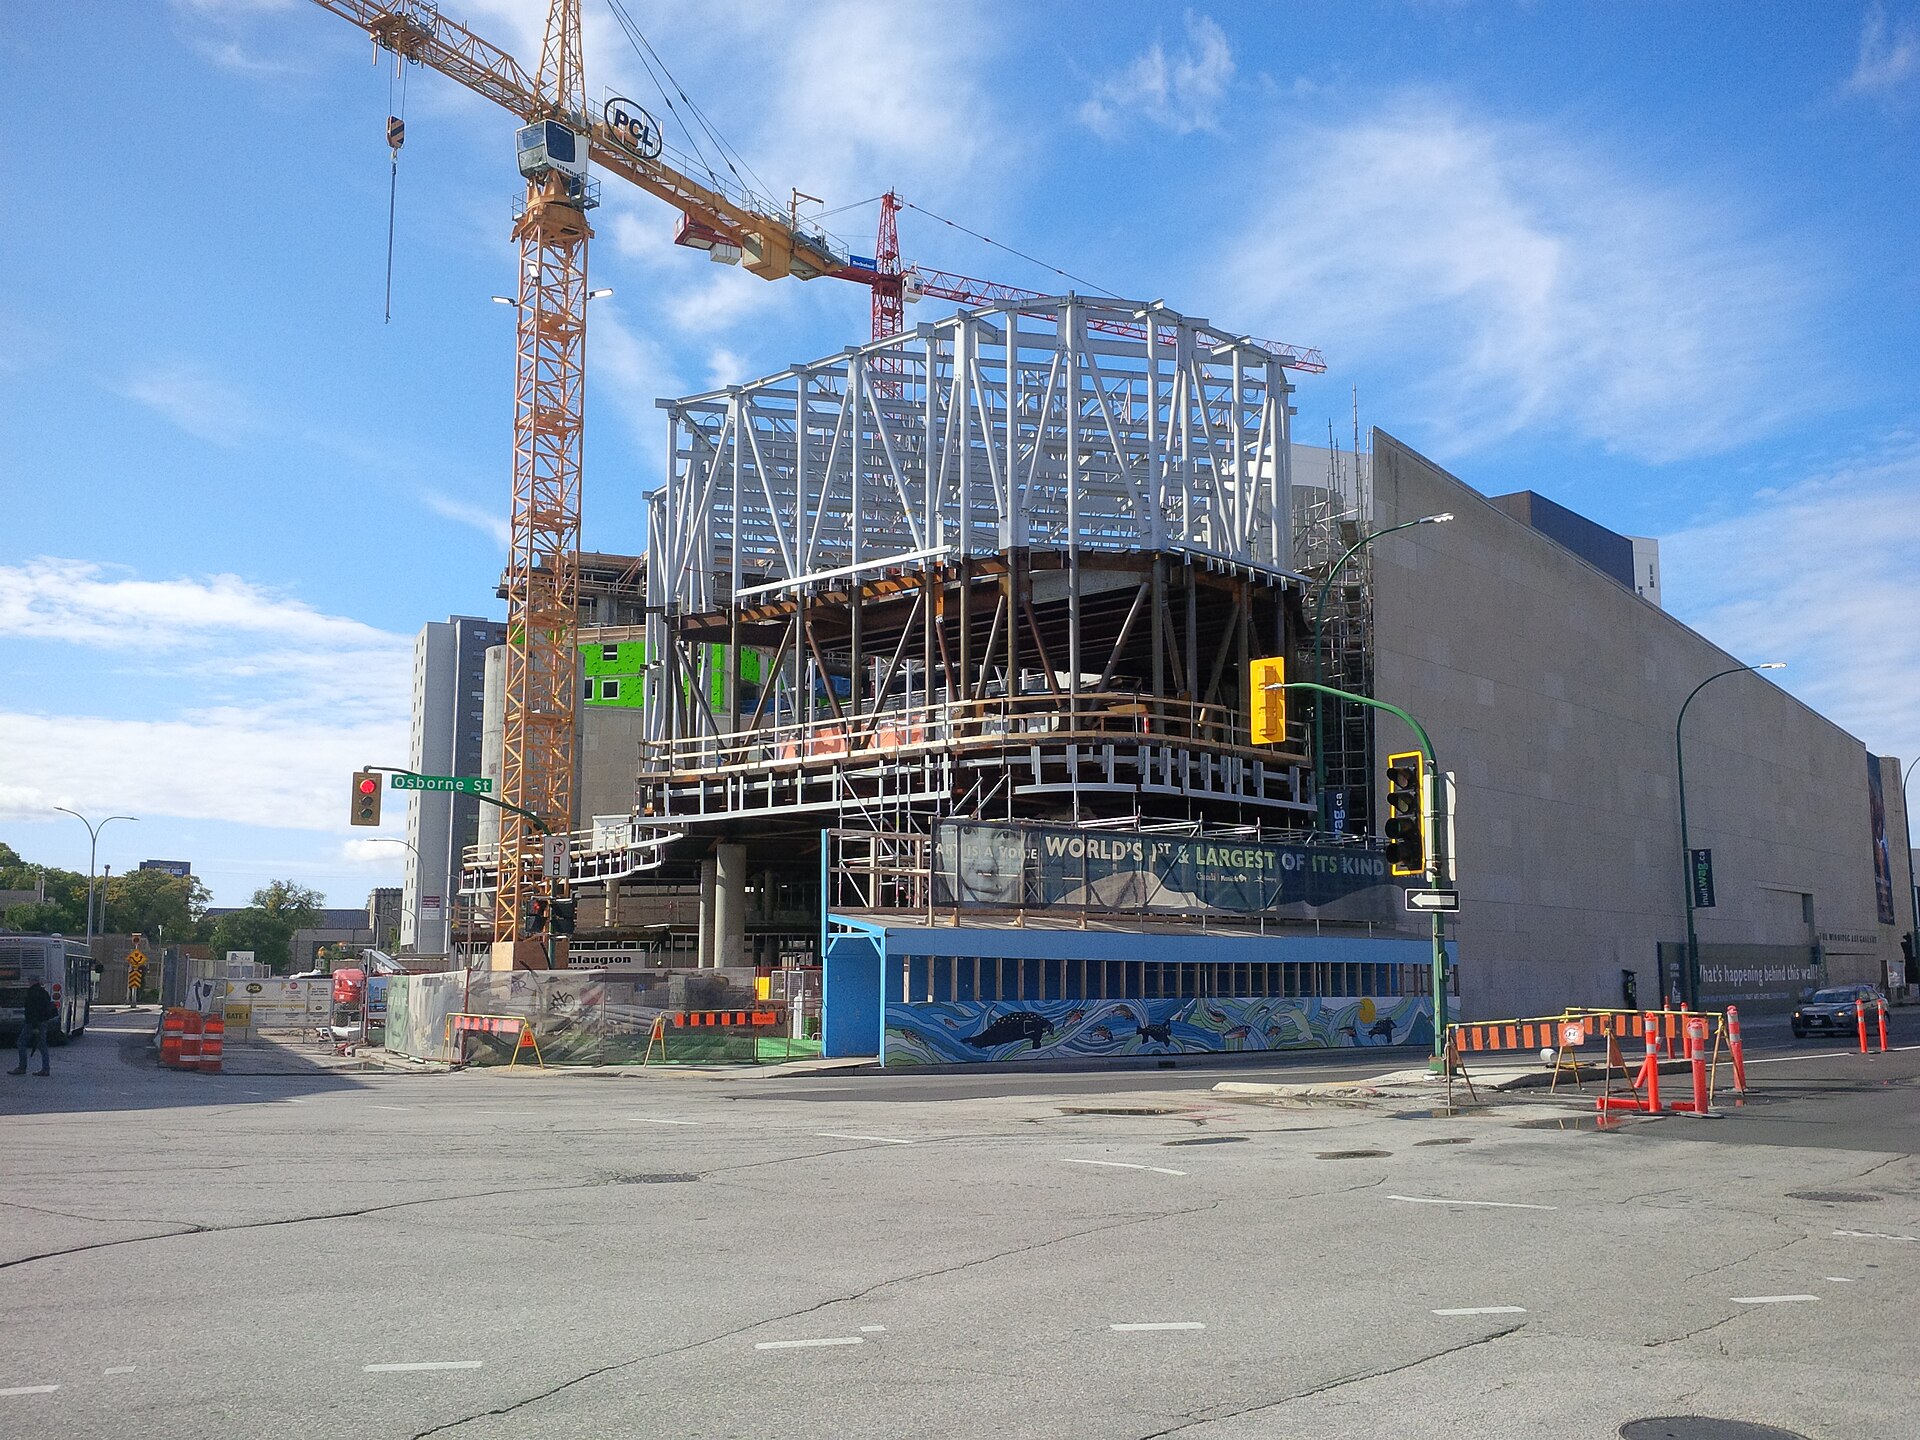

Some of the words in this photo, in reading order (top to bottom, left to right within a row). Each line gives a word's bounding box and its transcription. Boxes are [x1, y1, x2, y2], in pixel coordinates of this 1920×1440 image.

[614, 108, 654, 148] PCL
[394, 776, 464, 790] Osborne
[473, 780, 489, 791] St
[967, 845, 979, 857] IS
[984, 845, 993, 857] A
[1045, 836, 1144, 862] WORLD'S
[1178, 843, 1190, 864] &
[1196, 846, 1276, 870] LARGEST
[1281, 852, 1305, 872] OF
[1312, 855, 1338, 873] ITS
[1342, 857, 1385, 876] KIND
[1723, 964, 1764, 987] happening
[1763, 964, 1787, 982] behind
[1787, 964, 1800, 981] this
[226, 1012, 243, 1020] GATE
